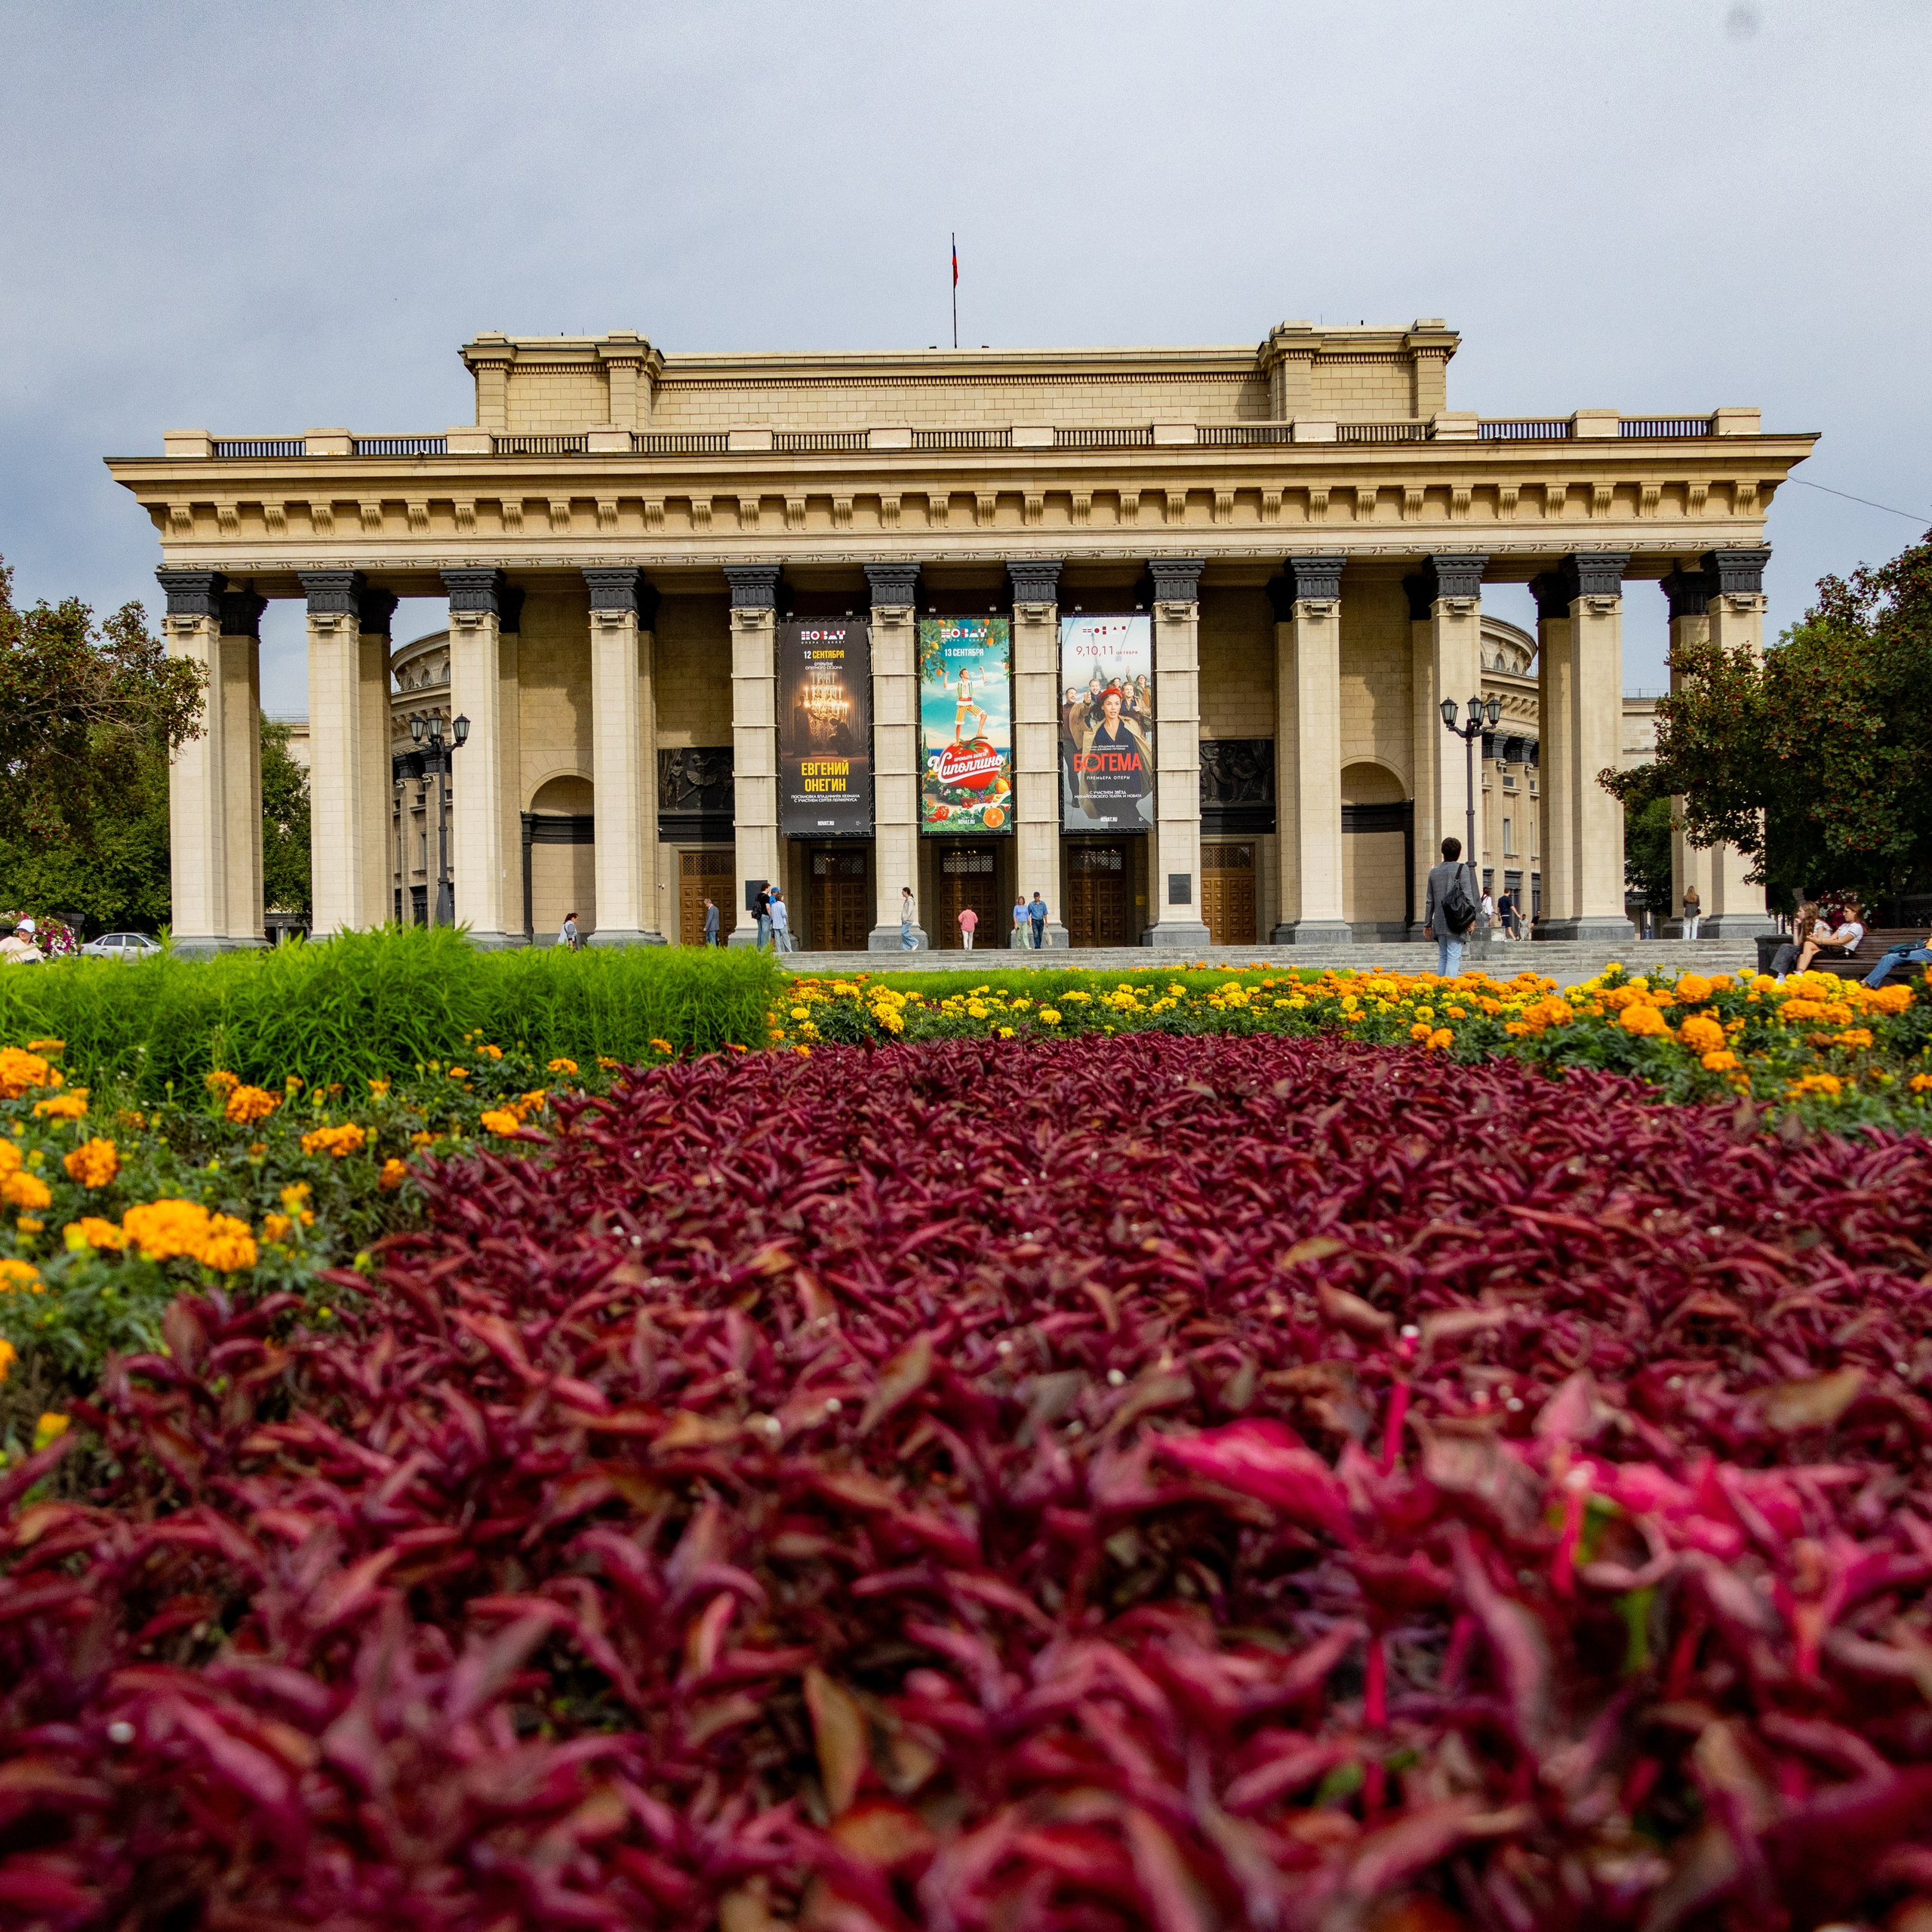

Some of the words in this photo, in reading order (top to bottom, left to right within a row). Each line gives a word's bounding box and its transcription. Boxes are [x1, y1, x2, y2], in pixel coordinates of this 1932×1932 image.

[804, 651, 811, 659] 12
[812, 650, 844, 659] СЕНТЯБРЯ
[944, 648, 952, 657] 13
[952, 648, 984, 657] СЕНТЯБРЯ
[801, 759, 849, 776] ЕВГЕНИЙ
[928, 752, 1004, 783] Чиполлино
[1073, 752, 1143, 772] БОГЕМА
[804, 778, 846, 792] ОНЕГИН
